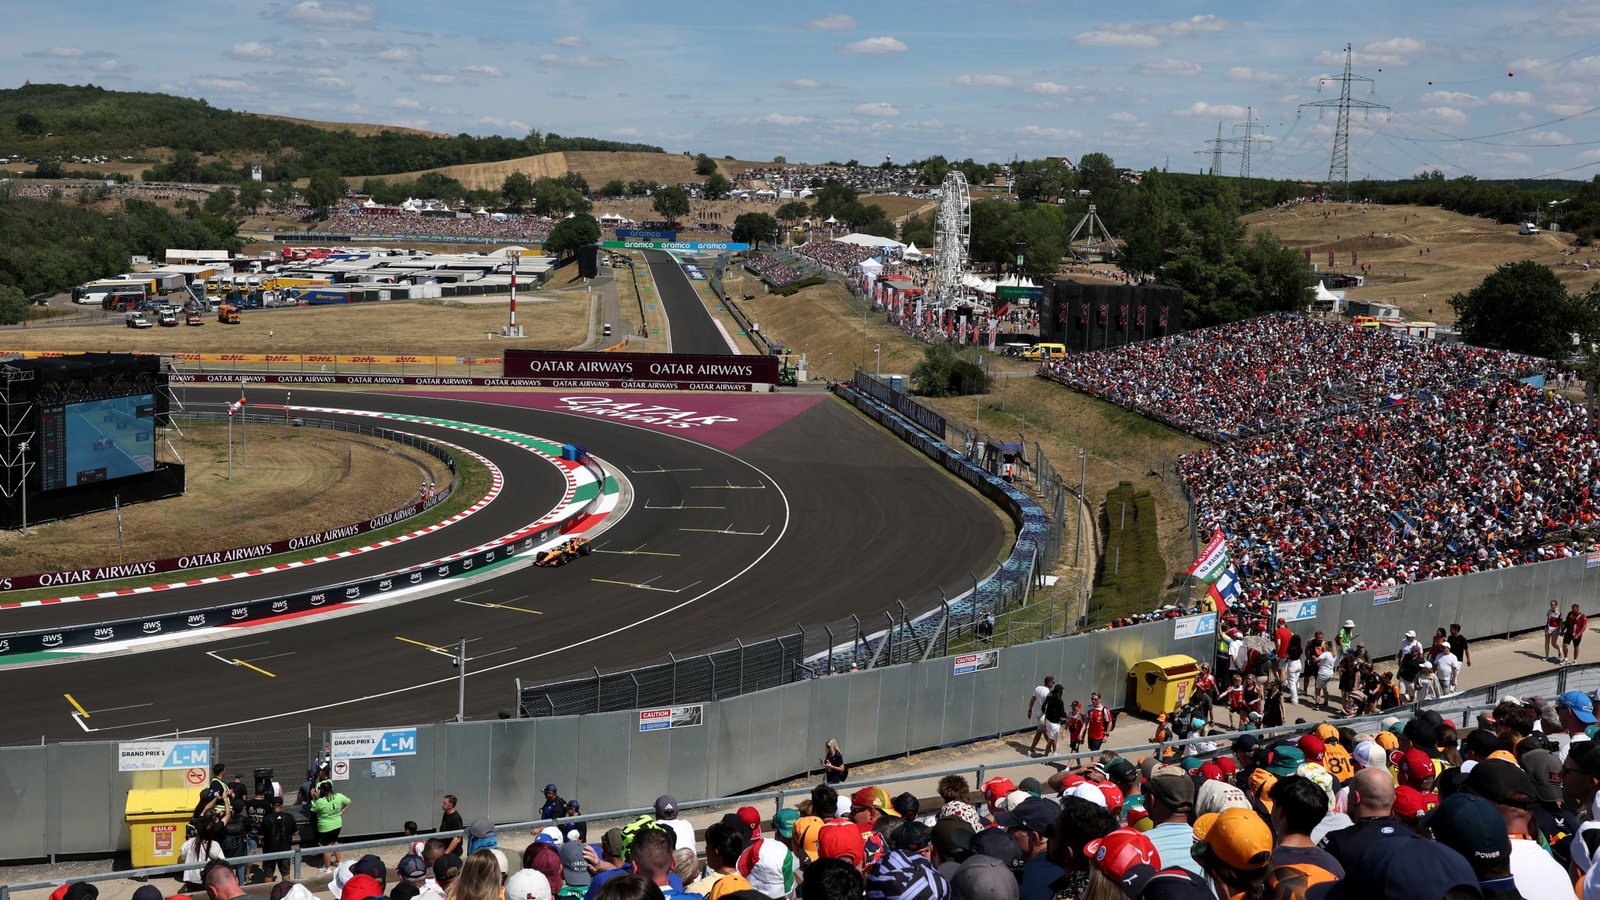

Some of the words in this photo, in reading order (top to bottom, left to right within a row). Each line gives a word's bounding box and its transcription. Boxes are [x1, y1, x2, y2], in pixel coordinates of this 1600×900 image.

[630, 230, 661, 238] aramco
[530, 360, 574, 372] QATAR
[577, 361, 633, 373] AIRWAYS
[650, 363, 694, 375] QATAR
[697, 364, 752, 376] AIRWAYS
[560, 397, 738, 425] QATAR
[370, 514, 393, 530] QATAR
[393, 506, 417, 521] AIRWAYS
[288, 533, 322, 550] QATAR
[323, 524, 359, 542] AIRWAYS
[178, 552, 221, 569] QATAR
[223, 544, 272, 562] AIRWAYS
[39, 569, 91, 586] QATAR
[95, 562, 156, 580] AIRWAYS
[439, 565, 449, 574] aws
[411, 572, 422, 580] aws
[380, 579, 392, 588] aws
[346, 586, 360, 596] aws
[311, 594, 325, 602] aws
[272, 601, 288, 610] aws
[1301, 604, 1316, 616] A-B
[231, 607, 248, 617] aws
[188, 614, 205, 624] aws
[143, 621, 161, 631] aws
[1199, 619, 1214, 631] A-B
[94, 627, 113, 637] aws
[42, 634, 62, 643] aws
[643, 710, 669, 718] CAUTION
[382, 736, 414, 752] L-M
[172, 750, 207, 765] L-M
[1328, 757, 1351, 774] 81
[1475, 851, 1500, 859] POWER
